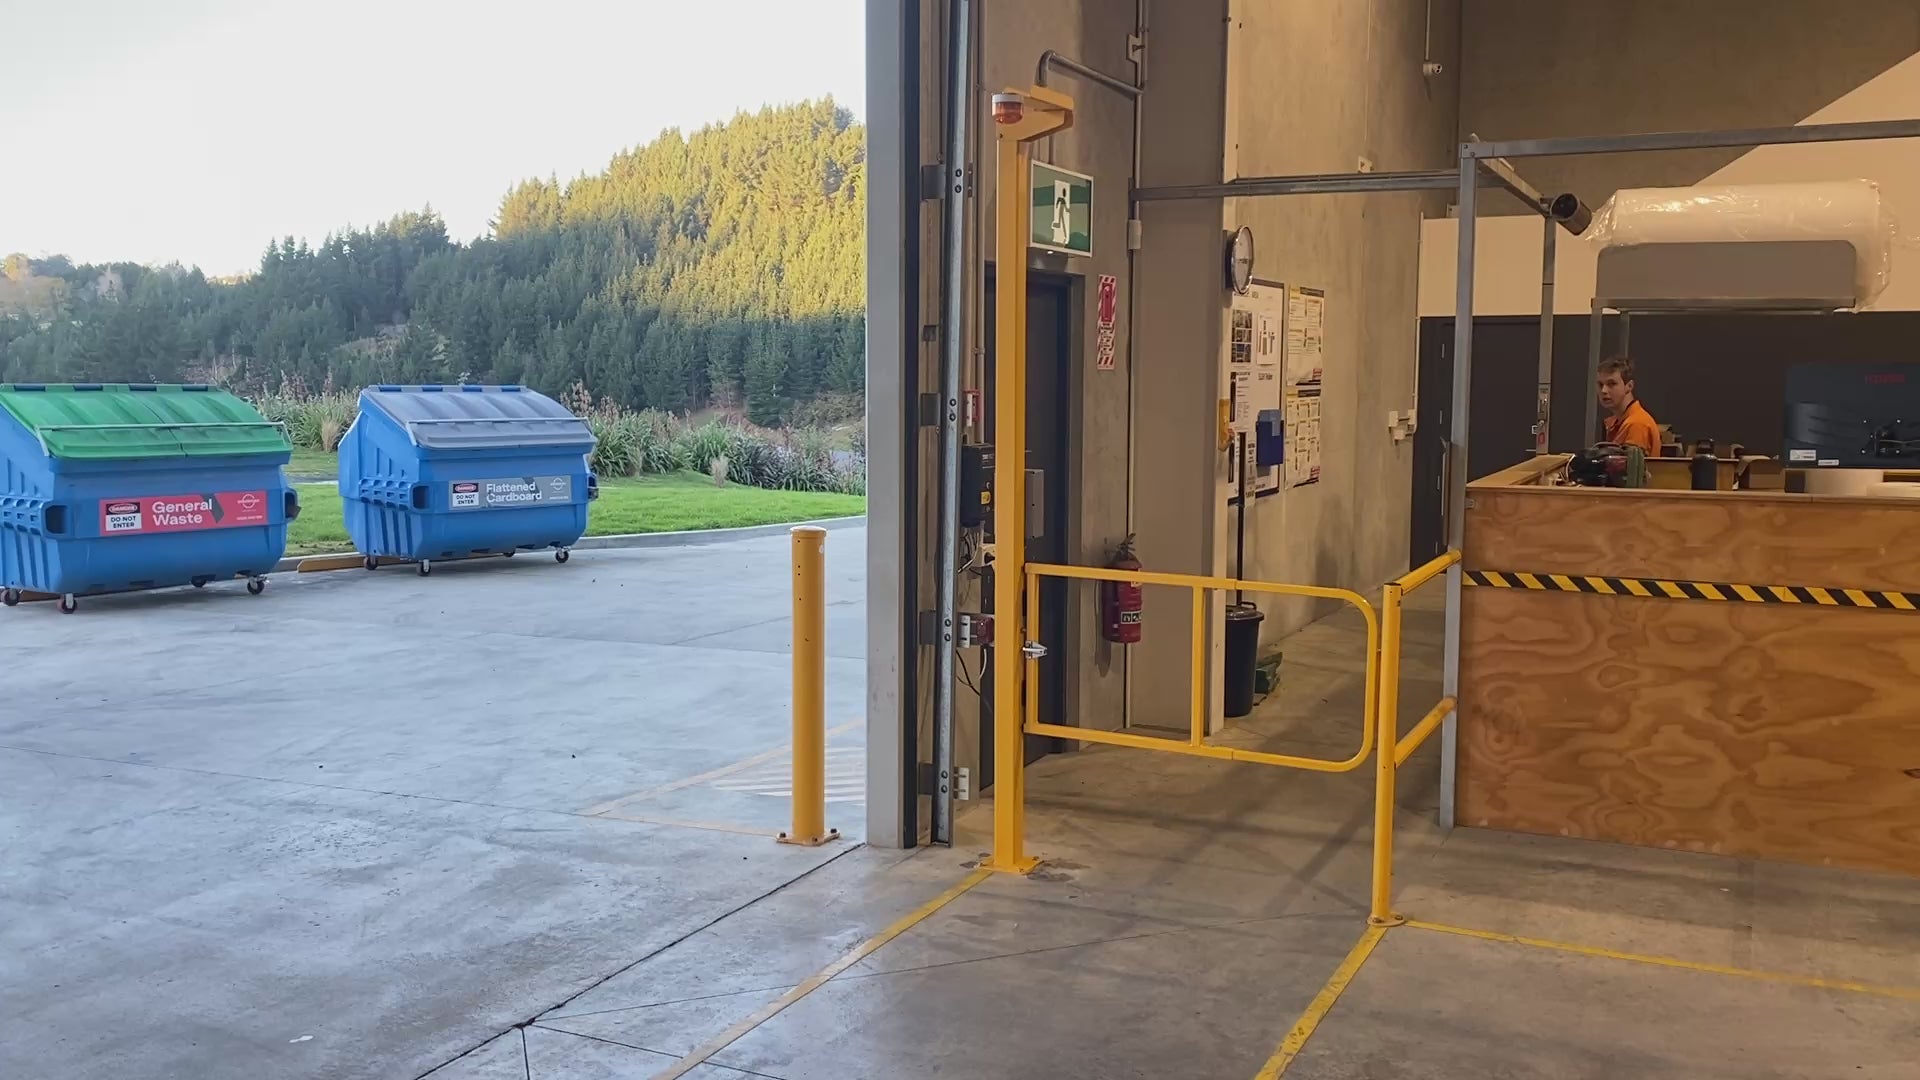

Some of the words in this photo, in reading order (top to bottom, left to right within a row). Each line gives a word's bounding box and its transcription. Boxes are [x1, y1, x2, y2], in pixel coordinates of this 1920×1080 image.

[486, 482, 536, 493] Flattened
[486, 491, 542, 503] Cardboard
[152, 499, 212, 513] General
[153, 513, 202, 526] Waste
